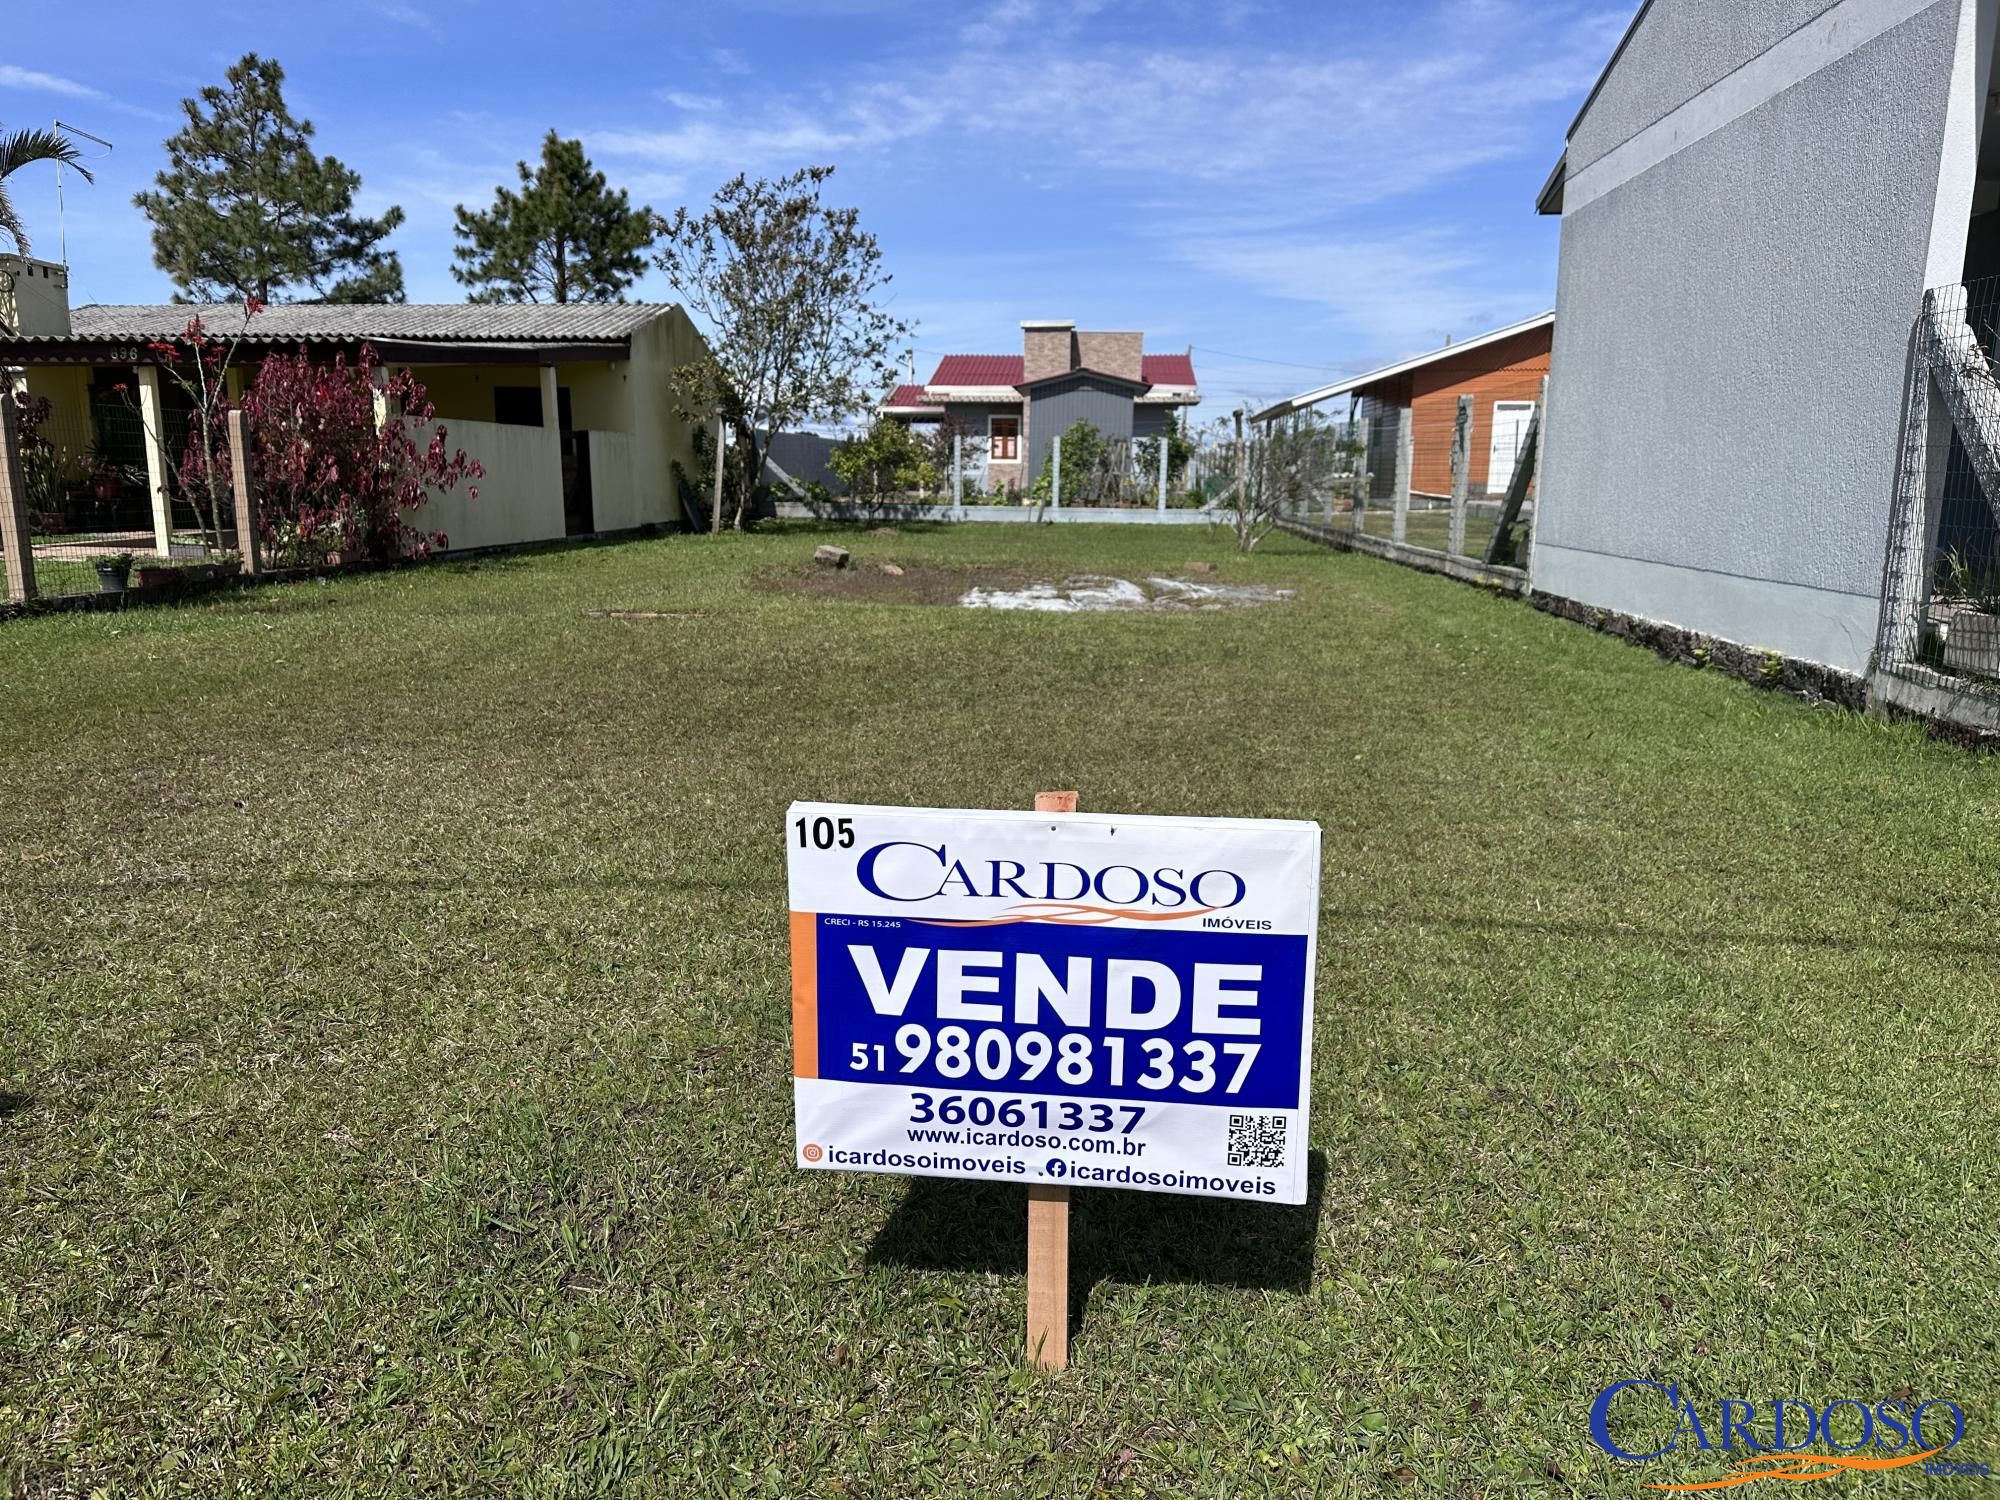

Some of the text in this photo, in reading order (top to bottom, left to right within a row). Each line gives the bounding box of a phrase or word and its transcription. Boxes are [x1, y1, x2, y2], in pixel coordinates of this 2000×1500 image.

[795, 817, 855, 850] 105
[856, 841, 1246, 908] CARDOSO
[824, 917, 851, 926] CRECI
[858, 919, 870, 927] RS
[872, 920, 901, 928] 15.245
[1202, 916, 1272, 931] IMÓVEIS
[847, 945, 1263, 1036] VENDE
[849, 1024, 1262, 1094] 51 980981337
[909, 1092, 1146, 1134] 36061337
[907, 1128, 1146, 1157] www.icardoso.com.br
[828, 1145, 1277, 1195] icardosoimoveis icardosoimoveis
